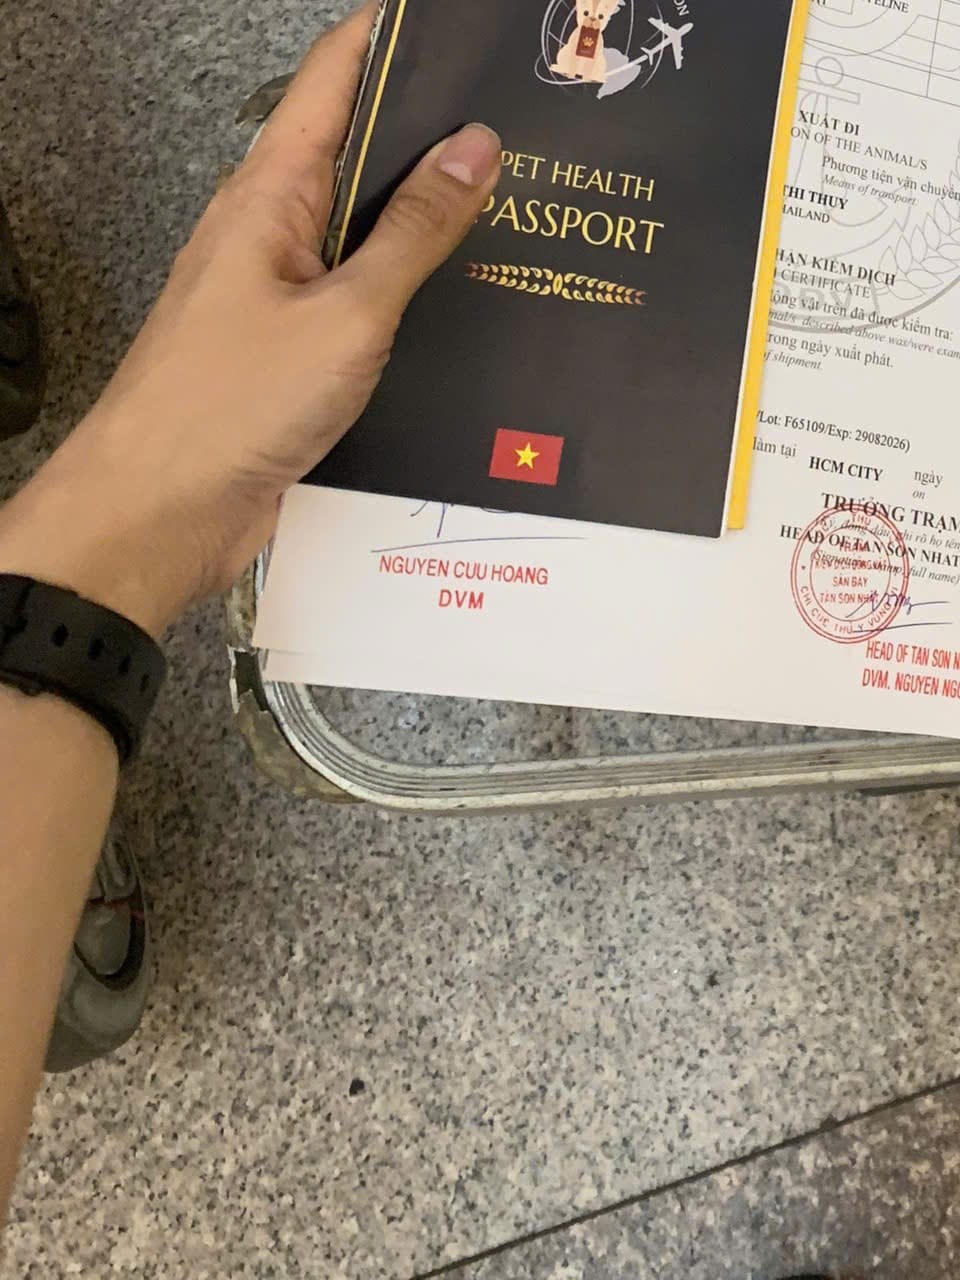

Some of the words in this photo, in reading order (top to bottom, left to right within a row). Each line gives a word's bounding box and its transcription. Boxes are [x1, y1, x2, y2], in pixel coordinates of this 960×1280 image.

[814, 132, 833, 145] OF
[835, 137, 862, 154] THE
[864, 145, 928, 171] ANIMAL/S
[501, 151, 546, 180] PET
[552, 161, 655, 202] HEALTH
[822, 155, 868, 180] Phương
[871, 168, 893, 184] tiện
[822, 174, 855, 190] Means
[858, 184, 869, 194] of
[808, 190, 849, 210] THUY
[781, 269, 871, 299] CERTIFICATE
[857, 267, 896, 286] DỊCH
[802, 315, 854, 335] described
[855, 327, 886, 342] above
[934, 326, 954, 341] tra:
[801, 338, 832, 357] ngày
[835, 343, 861, 361] xuất
[784, 415, 852, 441] F65109/Exp:
[855, 429, 911, 453] 29082026)
[752, 436, 777, 454] làm
[780, 443, 797, 459] tại
[809, 456, 844, 475] HCM
[848, 463, 883, 482] CITY
[913, 470, 943, 488] ngày
[912, 488, 925, 500] on
[780, 525, 824, 545] HEAD
[887, 540, 917, 560] SON
[379, 554, 450, 577] NGUYEN
[453, 561, 487, 580] CUU
[491, 564, 549, 585] HOANG
[928, 572, 960, 585] name)
[438, 589, 485, 609] DVM
[866, 640, 894, 661] HEAD
[896, 643, 909, 663] OF
[912, 645, 930, 666] TAN
[932, 648, 952, 669] SON
[862, 668, 891, 690] DVM.
[895, 671, 940, 696] NGUYEN
